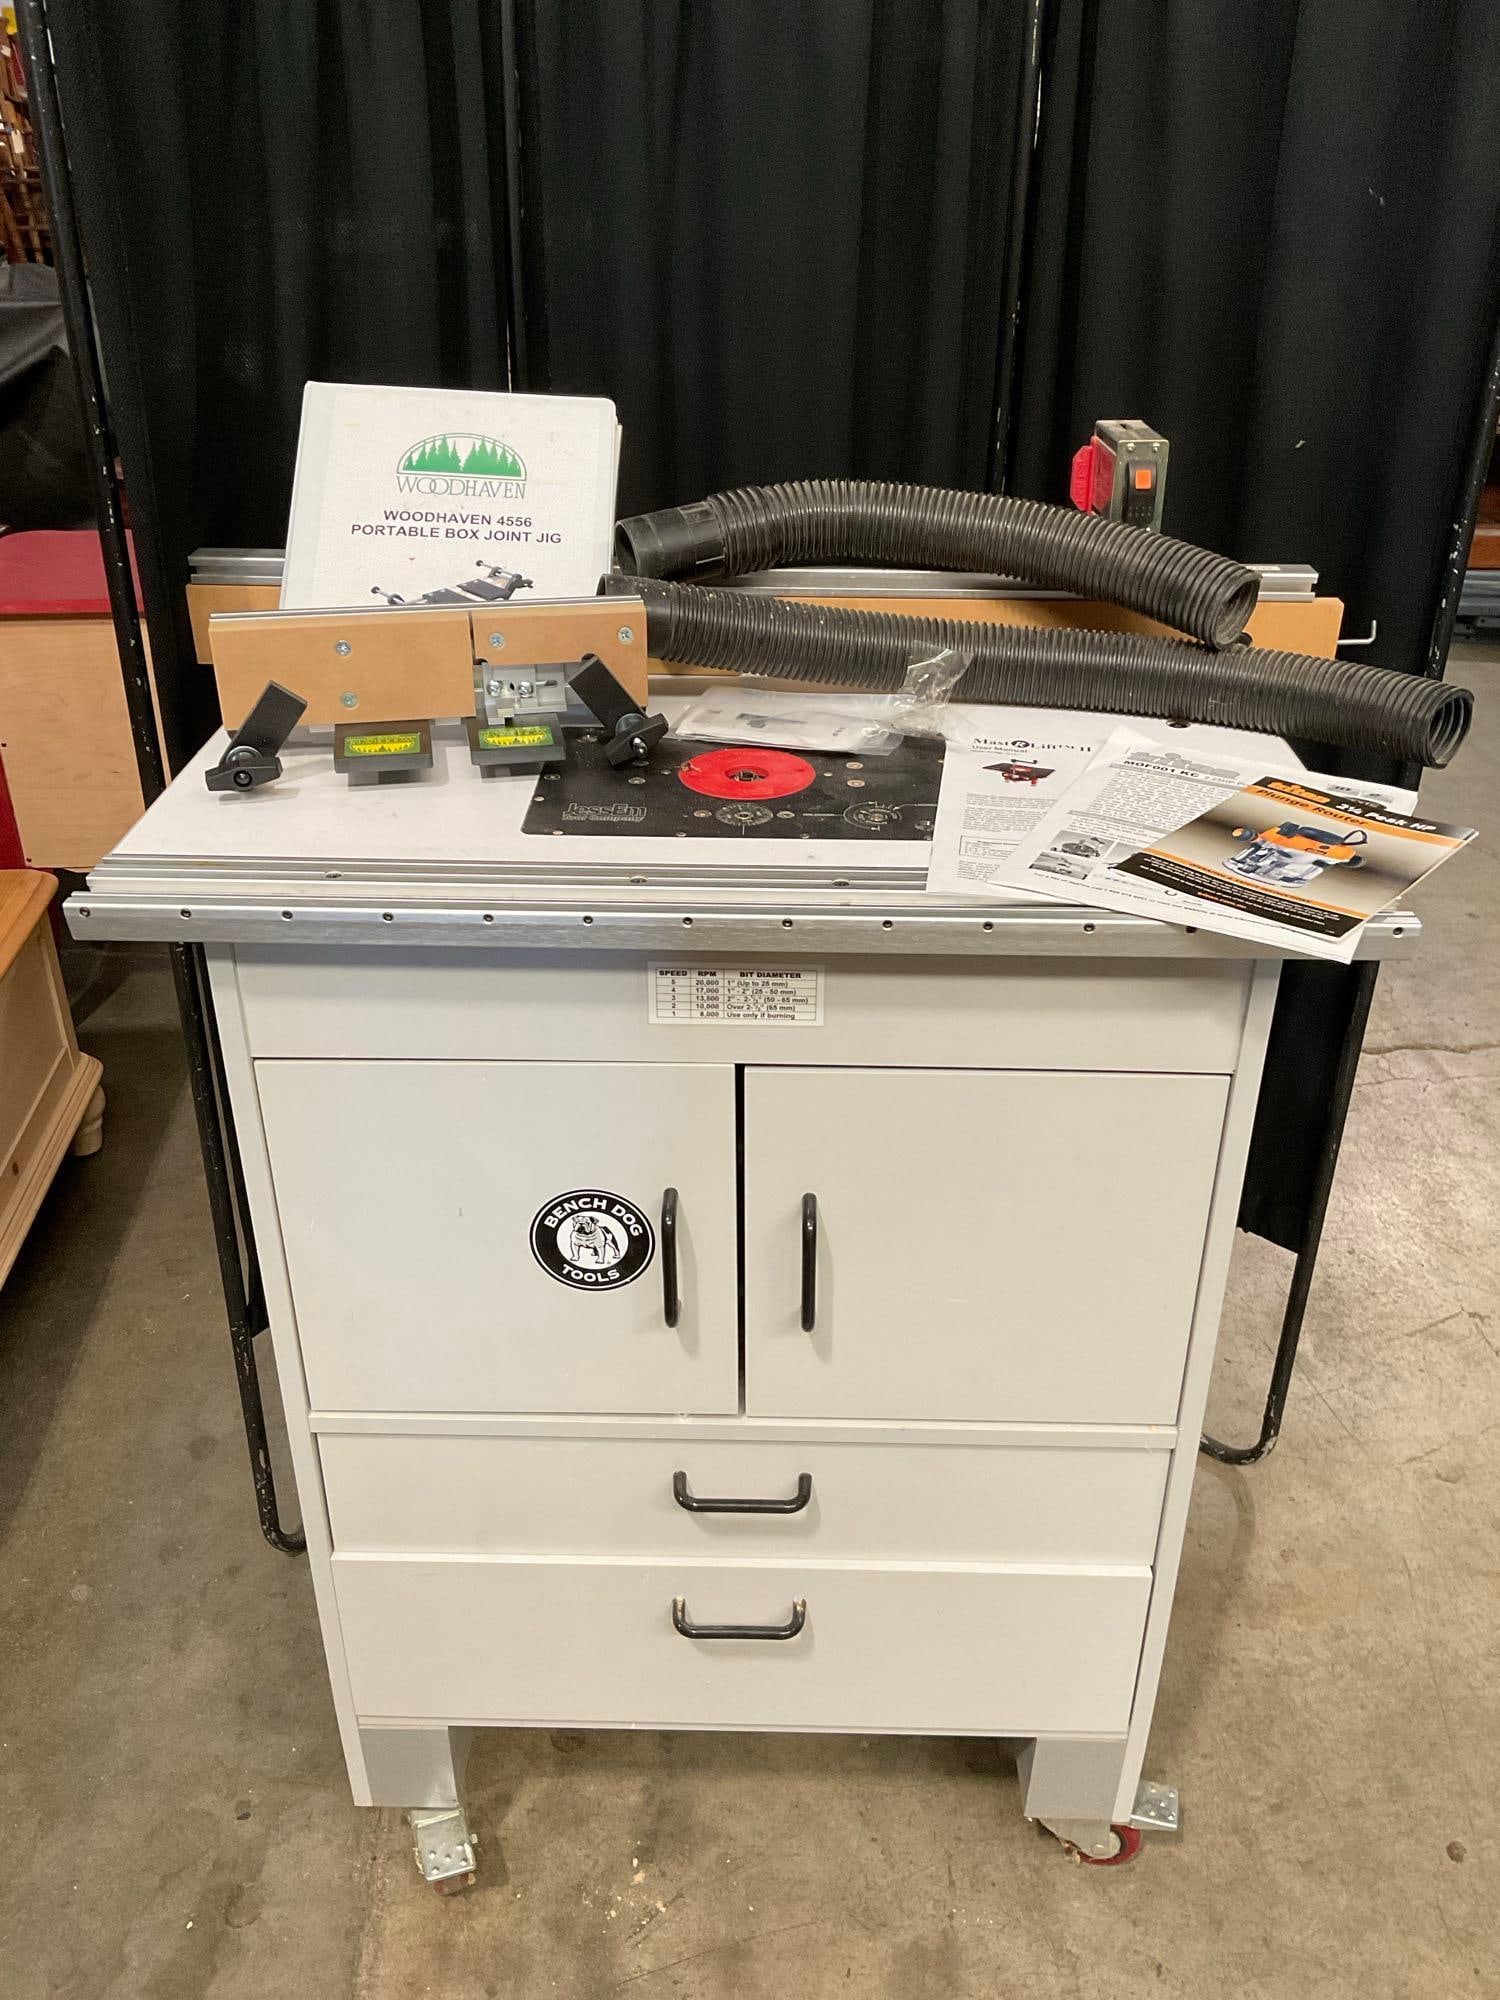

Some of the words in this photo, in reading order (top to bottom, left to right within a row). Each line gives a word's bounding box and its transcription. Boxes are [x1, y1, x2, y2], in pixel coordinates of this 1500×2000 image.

[396, 476, 526, 500] WOODHAVEN
[384, 510, 491, 525] WOODHAVEN
[496, 516, 532, 527] 4556
[351, 524, 439, 538] PORTABLE
[445, 528, 480, 540] BOX
[484, 530, 532, 542] JOINT
[536, 532, 562, 544] JIG
[1124, 760, 1175, 773] MOF001
[1257, 789, 1309, 808] Plunge
[1314, 806, 1367, 826] Router
[1365, 812, 1408, 826] Peak
[1410, 822, 1437, 831] HP
[695, 987, 720, 995] 17,000
[737, 980, 750, 988] (Up
[752, 988, 763, 996] (25
[695, 1003, 720, 1011] 10,000
[792, 997, 808, 1005] mm)
[543, 1198, 608, 1228] BENCH
[610, 1204, 643, 1237] DOG
[561, 1263, 620, 1282] TOOLS
